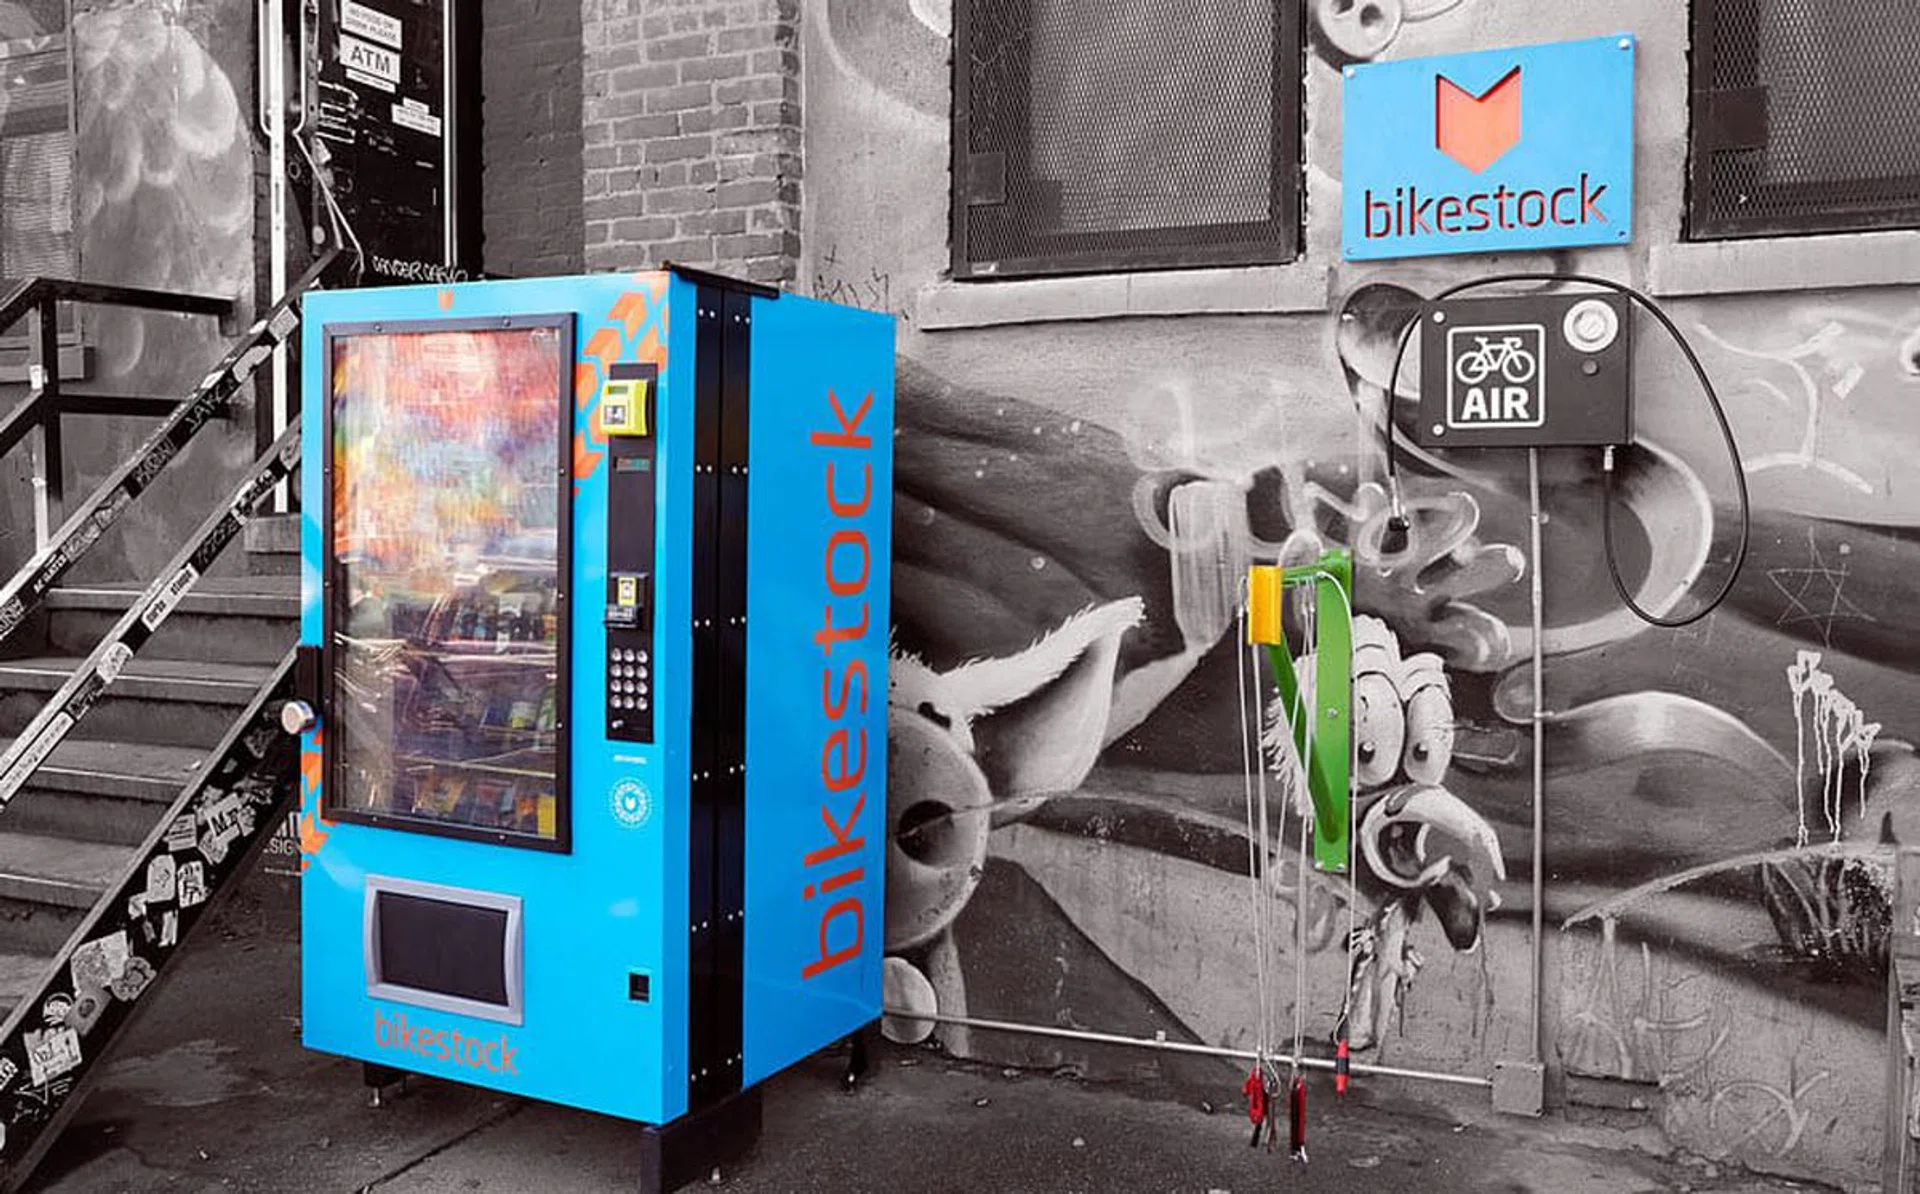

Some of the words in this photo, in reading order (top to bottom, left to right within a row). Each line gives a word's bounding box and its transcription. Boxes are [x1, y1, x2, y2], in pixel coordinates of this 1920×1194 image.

[351, 46, 390, 73] ATM
[1364, 173, 1607, 239] bikestock
[1461, 387, 1530, 420] AIR
[801, 388, 873, 980] bikestock
[374, 1009, 518, 1076] bikestock
